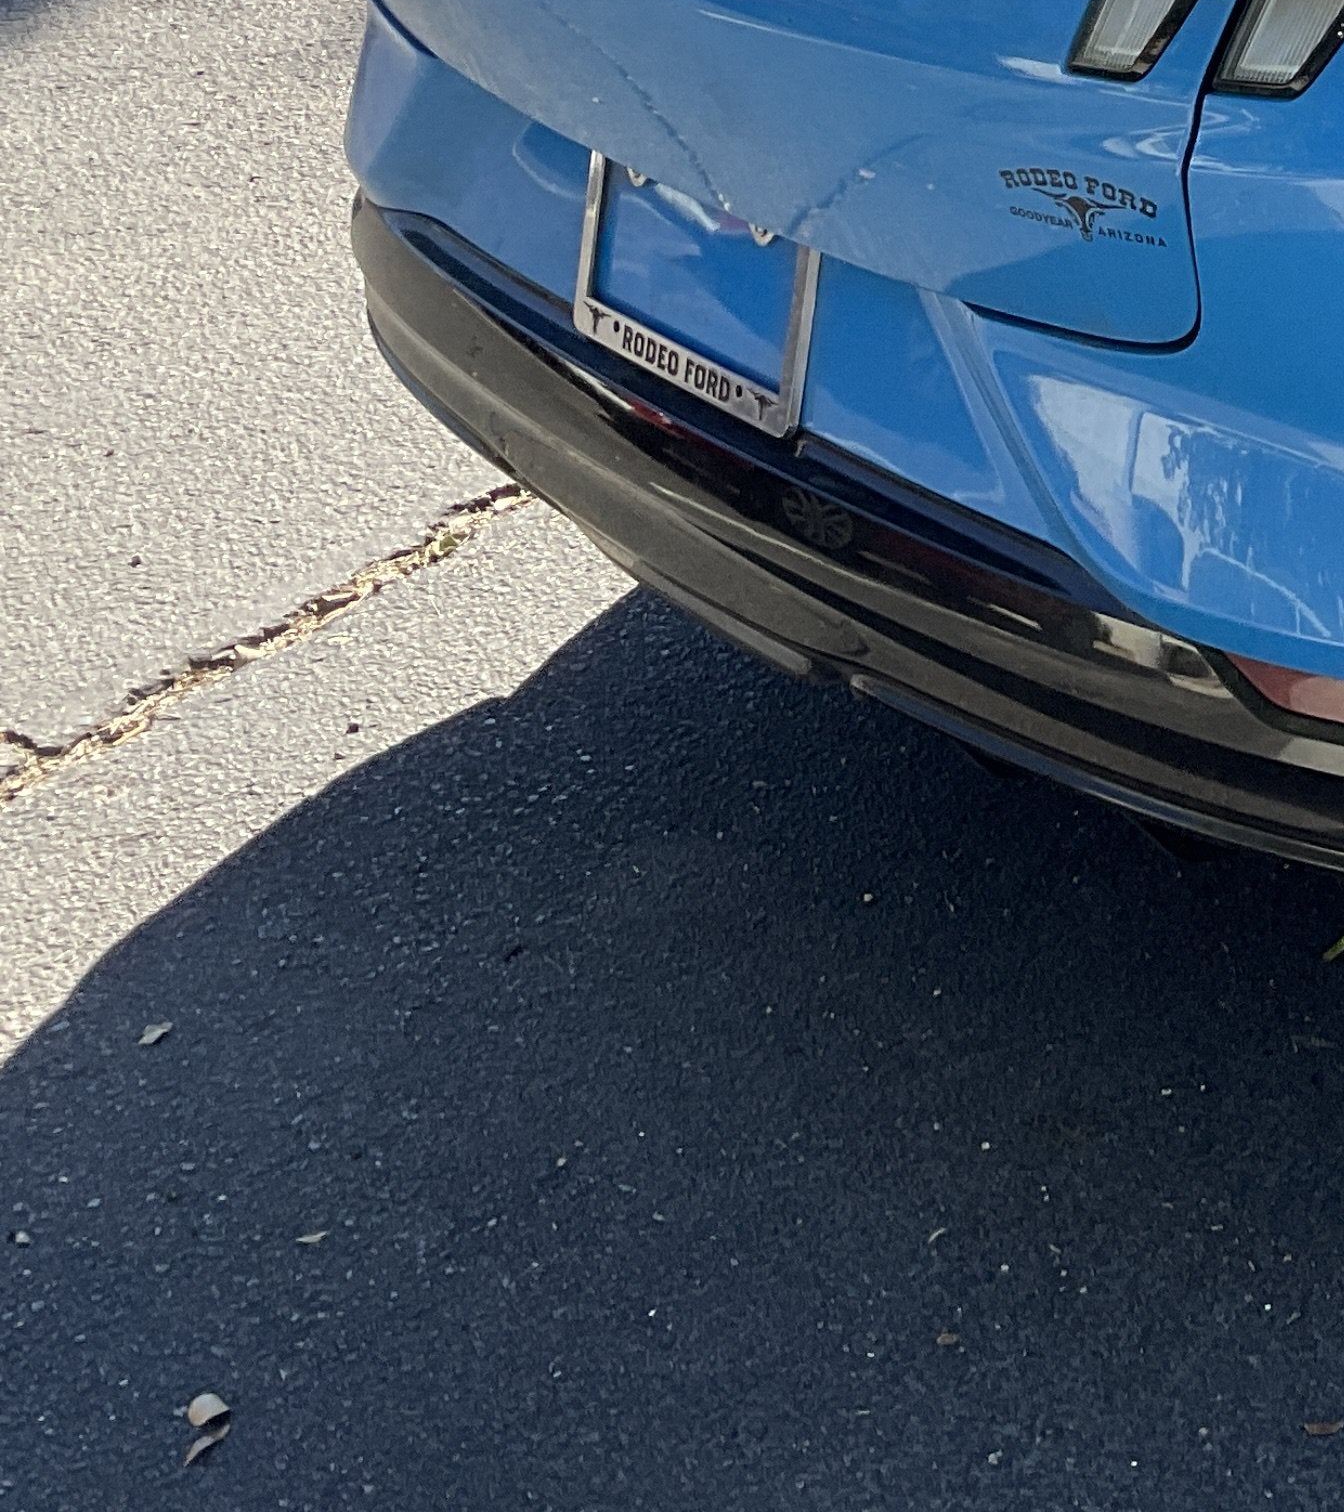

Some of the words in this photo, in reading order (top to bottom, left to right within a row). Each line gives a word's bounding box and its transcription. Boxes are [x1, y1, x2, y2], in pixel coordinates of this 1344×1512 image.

[999, 168, 1078, 189] RODEO
[1084, 176, 1158, 218] FORD
[1009, 206, 1073, 229] GOODYEAR
[1098, 226, 1168, 248] ARIZONA
[622, 324, 679, 376] RODEO
[684, 357, 730, 402] FORD
